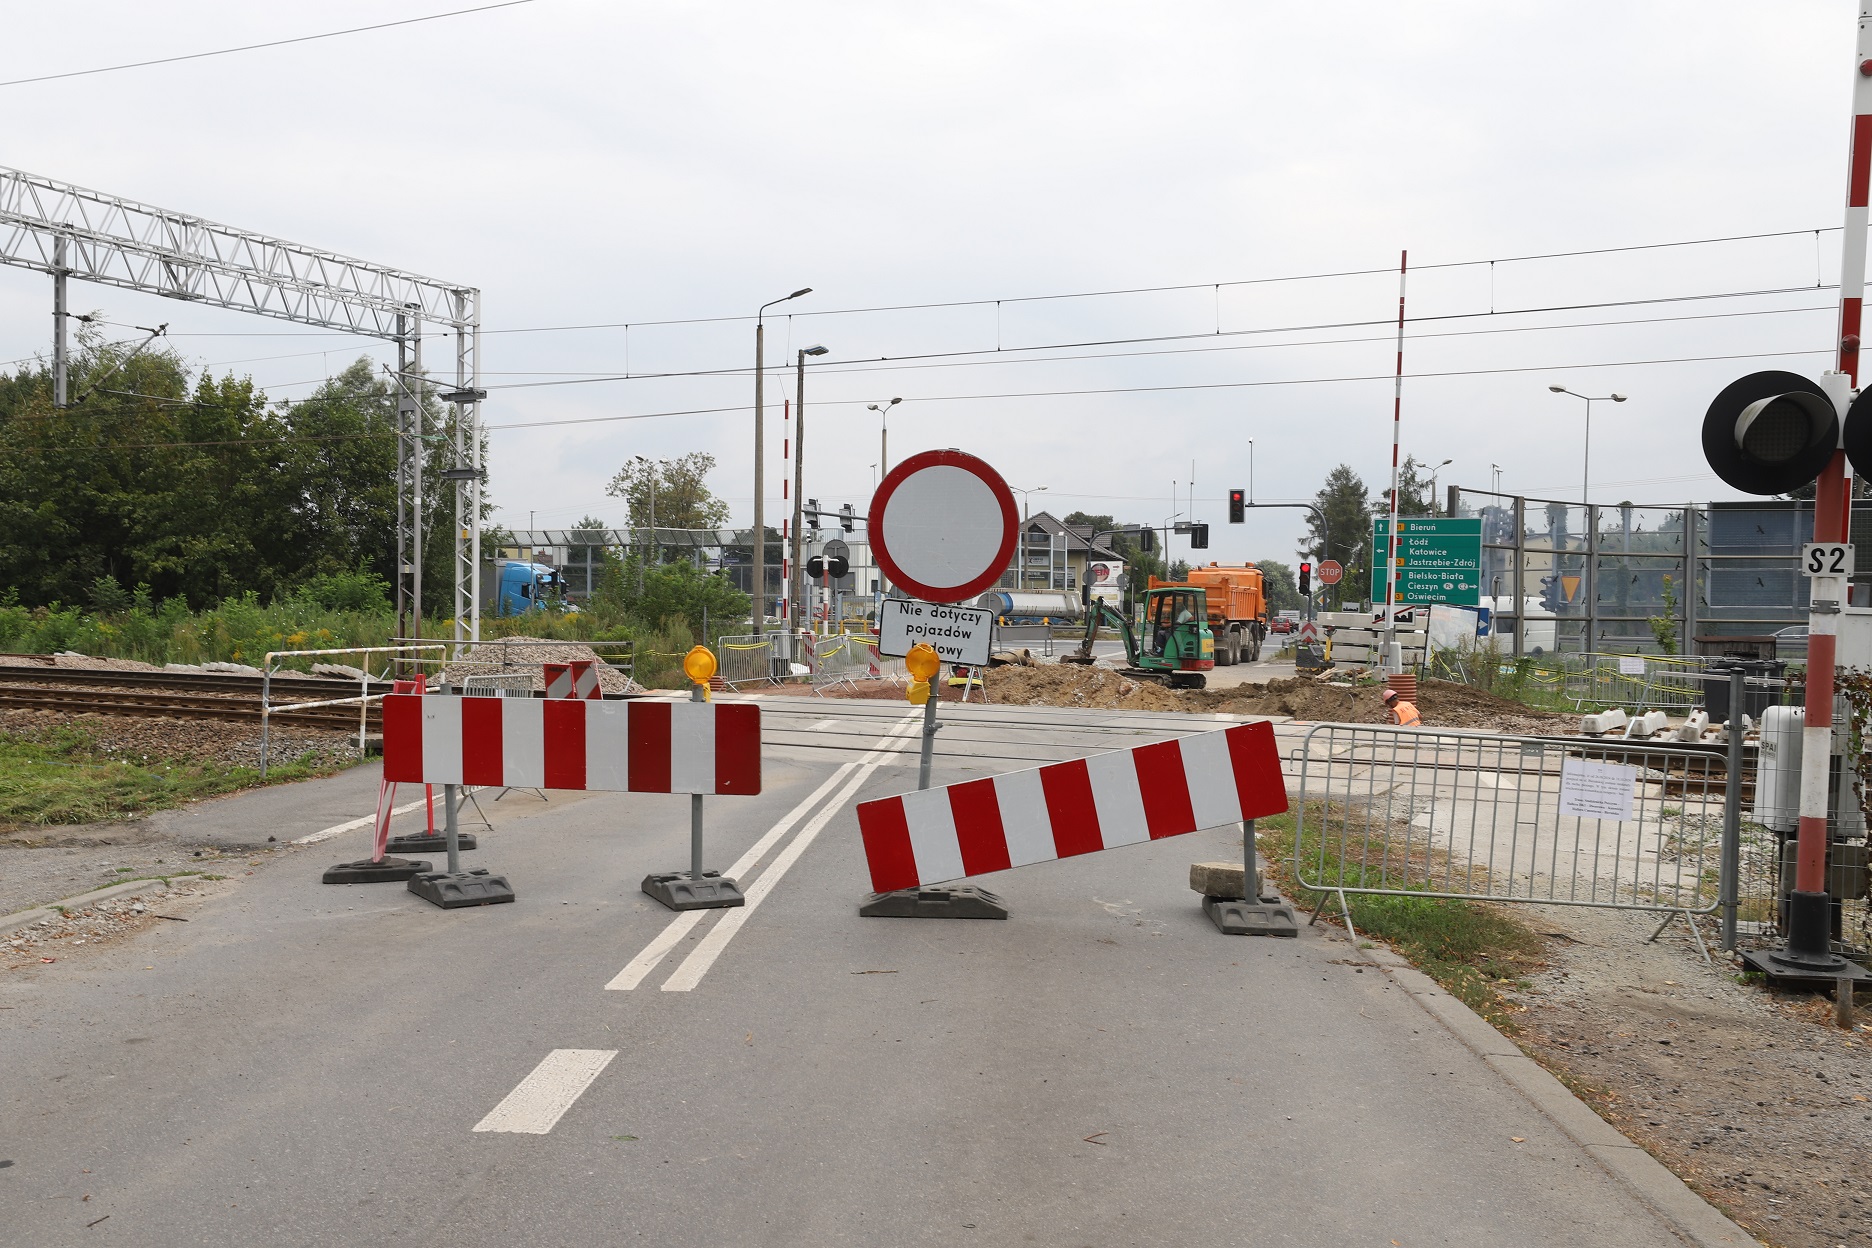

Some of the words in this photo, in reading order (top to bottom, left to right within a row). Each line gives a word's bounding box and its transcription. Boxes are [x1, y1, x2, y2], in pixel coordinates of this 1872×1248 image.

[1410, 522, 1436, 531] Bieruń
[1409, 538, 1429, 546] Łódź
[1409, 548, 1447, 556] Katowice
[1408, 558, 1476, 568] Jastrzębie-Zdrój
[1808, 547, 1845, 573] S2
[1320, 568, 1340, 576] STOP
[1408, 572, 1464, 580] Bielsko-Biała
[1408, 582, 1438, 591] Cieszyn
[900, 603, 922, 616] Nie
[930, 606, 982, 626] dotyczy
[906, 623, 972, 639] pojazdów
